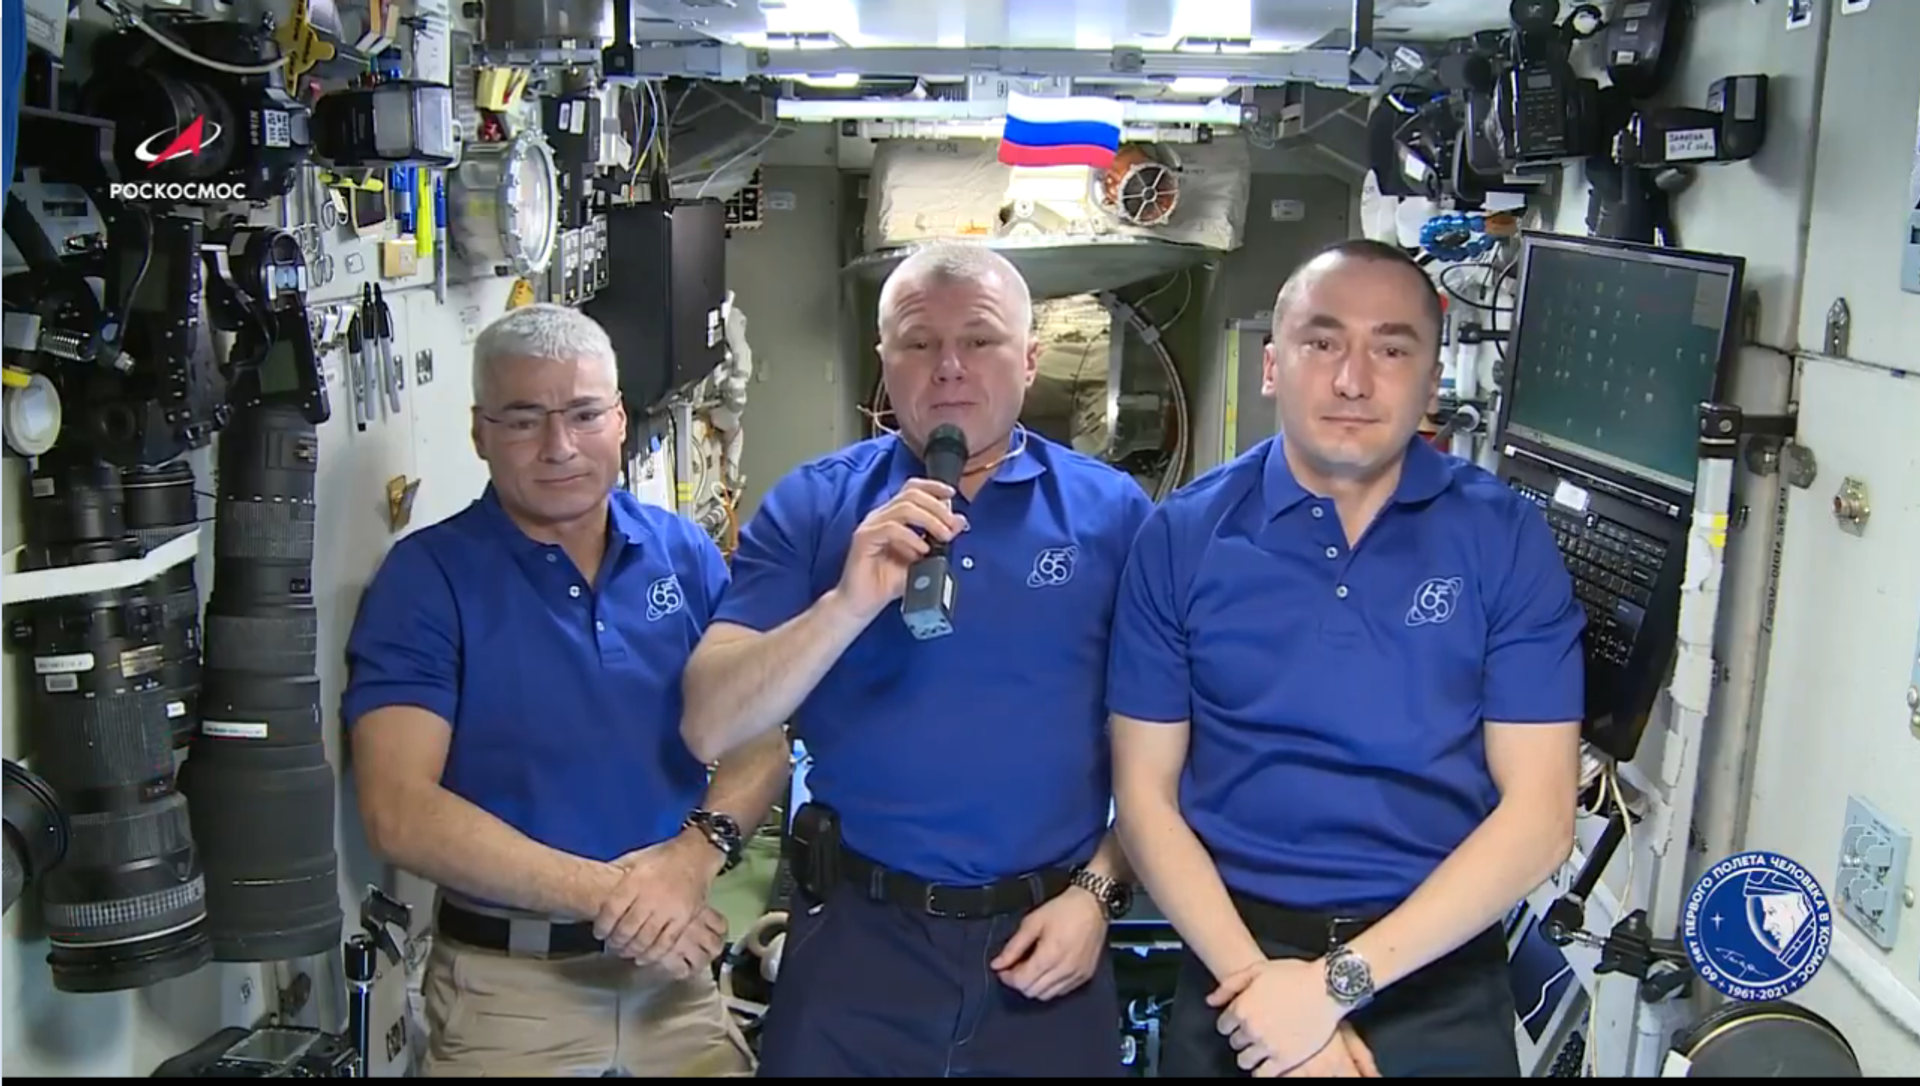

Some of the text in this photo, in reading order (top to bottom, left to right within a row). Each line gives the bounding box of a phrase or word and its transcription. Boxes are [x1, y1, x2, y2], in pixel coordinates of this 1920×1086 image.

[1039, 552, 1067, 580] 65
[652, 584, 679, 607] 65
[1420, 583, 1449, 617] 65
